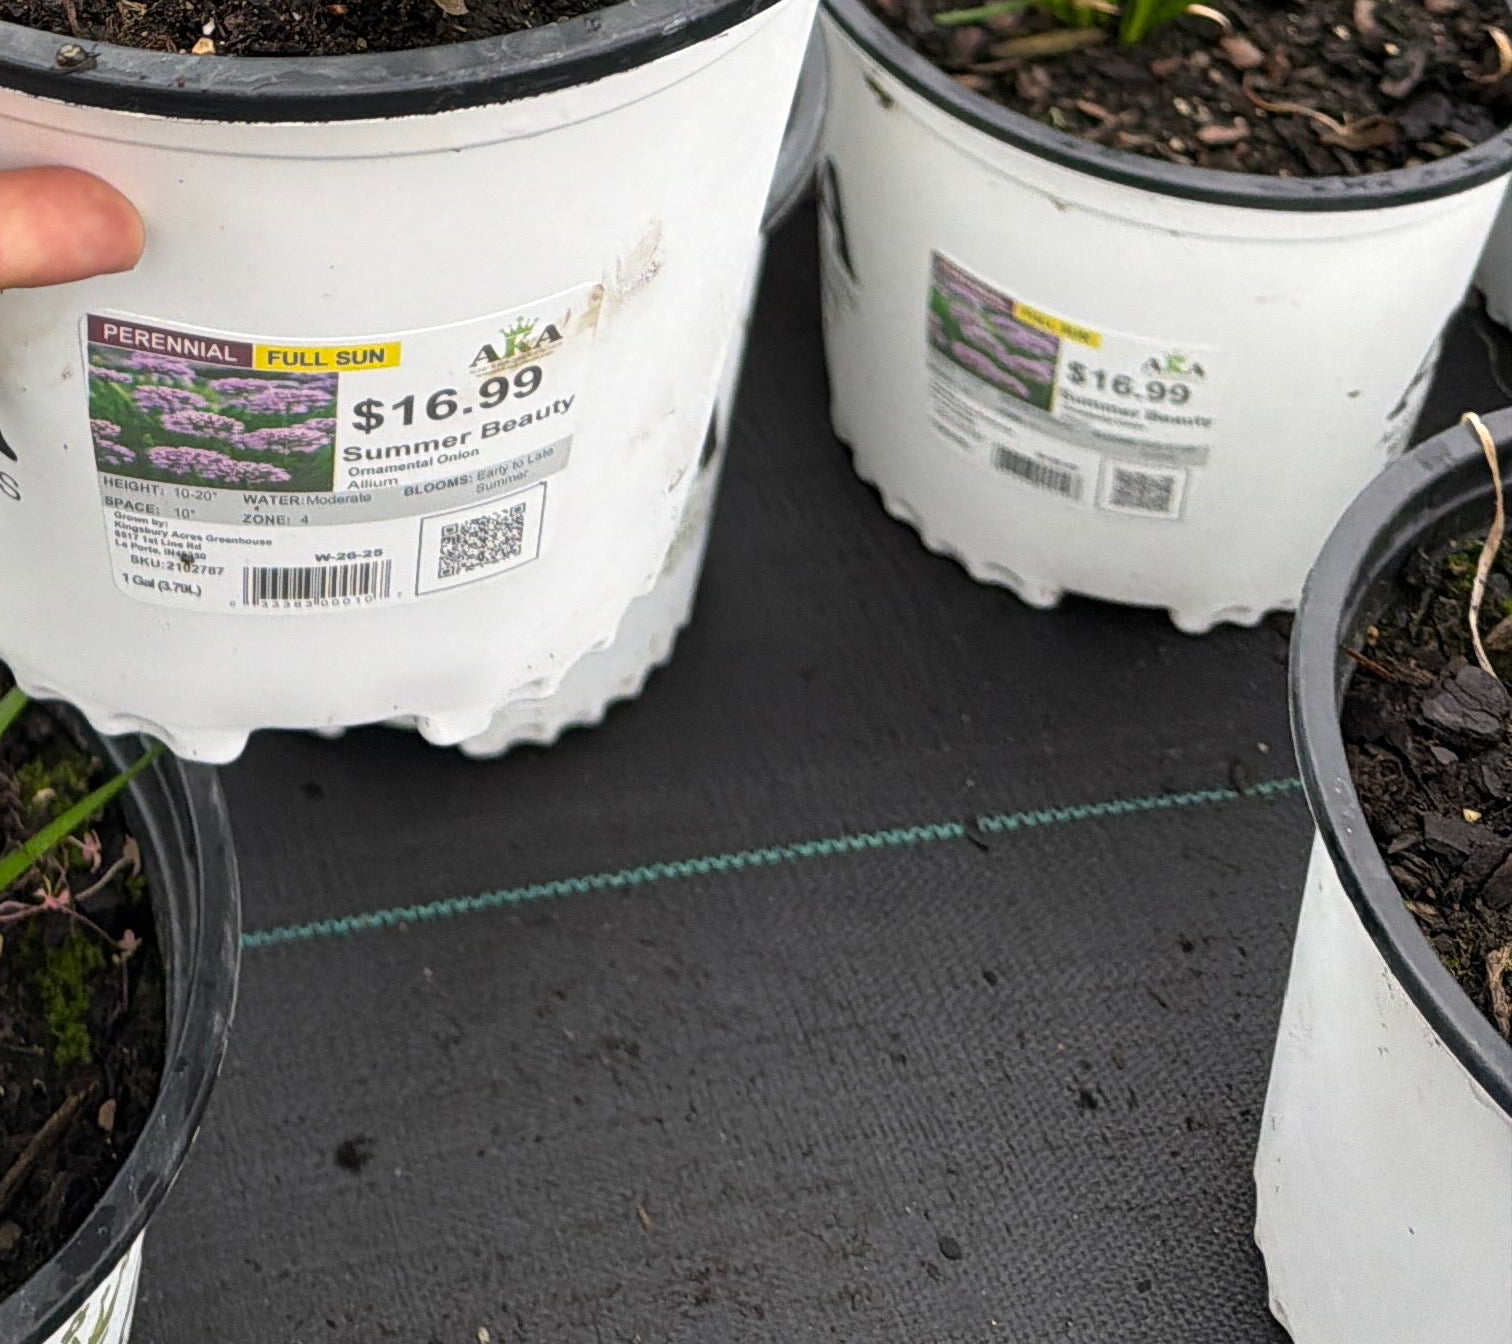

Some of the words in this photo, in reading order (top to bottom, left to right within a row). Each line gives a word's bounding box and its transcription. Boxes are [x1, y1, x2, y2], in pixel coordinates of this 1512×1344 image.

[103, 323, 238, 362] PERENNIAL
[469, 322, 563, 368] AKA
[267, 350, 328, 367] FULL
[335, 348, 384, 365] SUN
[1066, 361, 1191, 405] $16.99
[351, 365, 543, 435] $16.99
[342, 430, 472, 462] Summer
[480, 394, 576, 440] Beauty
[348, 457, 433, 477] Ornamental
[437, 447, 480, 464] Onion
[403, 475, 473, 497] BLOOMS:
[476, 462, 510, 482] Early
[511, 458, 524, 469] to
[527, 446, 555, 464] Late
[103, 476, 165, 497] HEIGHT:
[347, 476, 399, 490] Allium
[475, 468, 529, 495] Summer
[104, 495, 160, 514] SPACE:
[242, 513, 290, 526] ZONE:
[300, 514, 309, 525] 4
[205, 534, 273, 546] Greenhouse
[122, 572, 130, 583] 1
[132, 575, 155, 589] Gal
